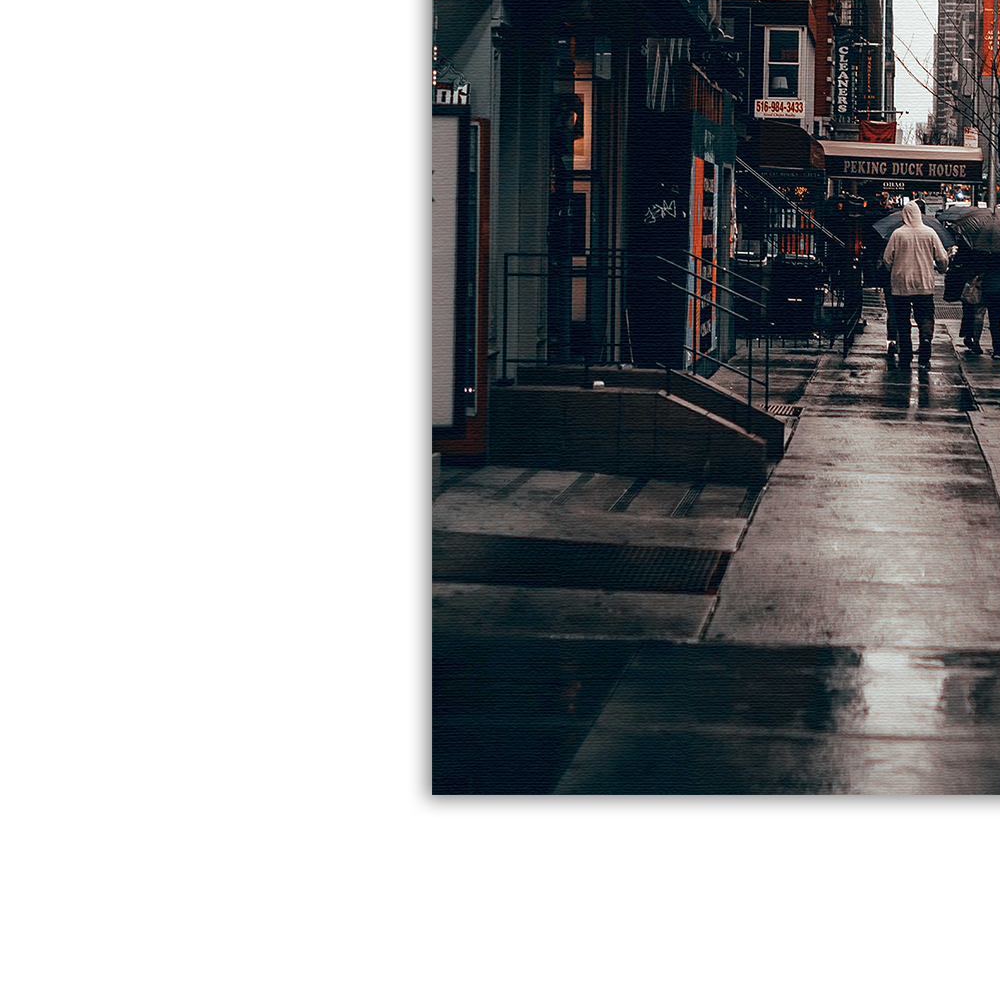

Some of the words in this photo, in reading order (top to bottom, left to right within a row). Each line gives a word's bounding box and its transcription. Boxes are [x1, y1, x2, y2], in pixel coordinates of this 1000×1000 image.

[837, 46, 850, 113] CLEANERS
[756, 101, 804, 113] 516-984-3433
[843, 160, 888, 175] PEKING
[892, 162, 924, 176] DUCK
[928, 163, 967, 178] HOUSE
